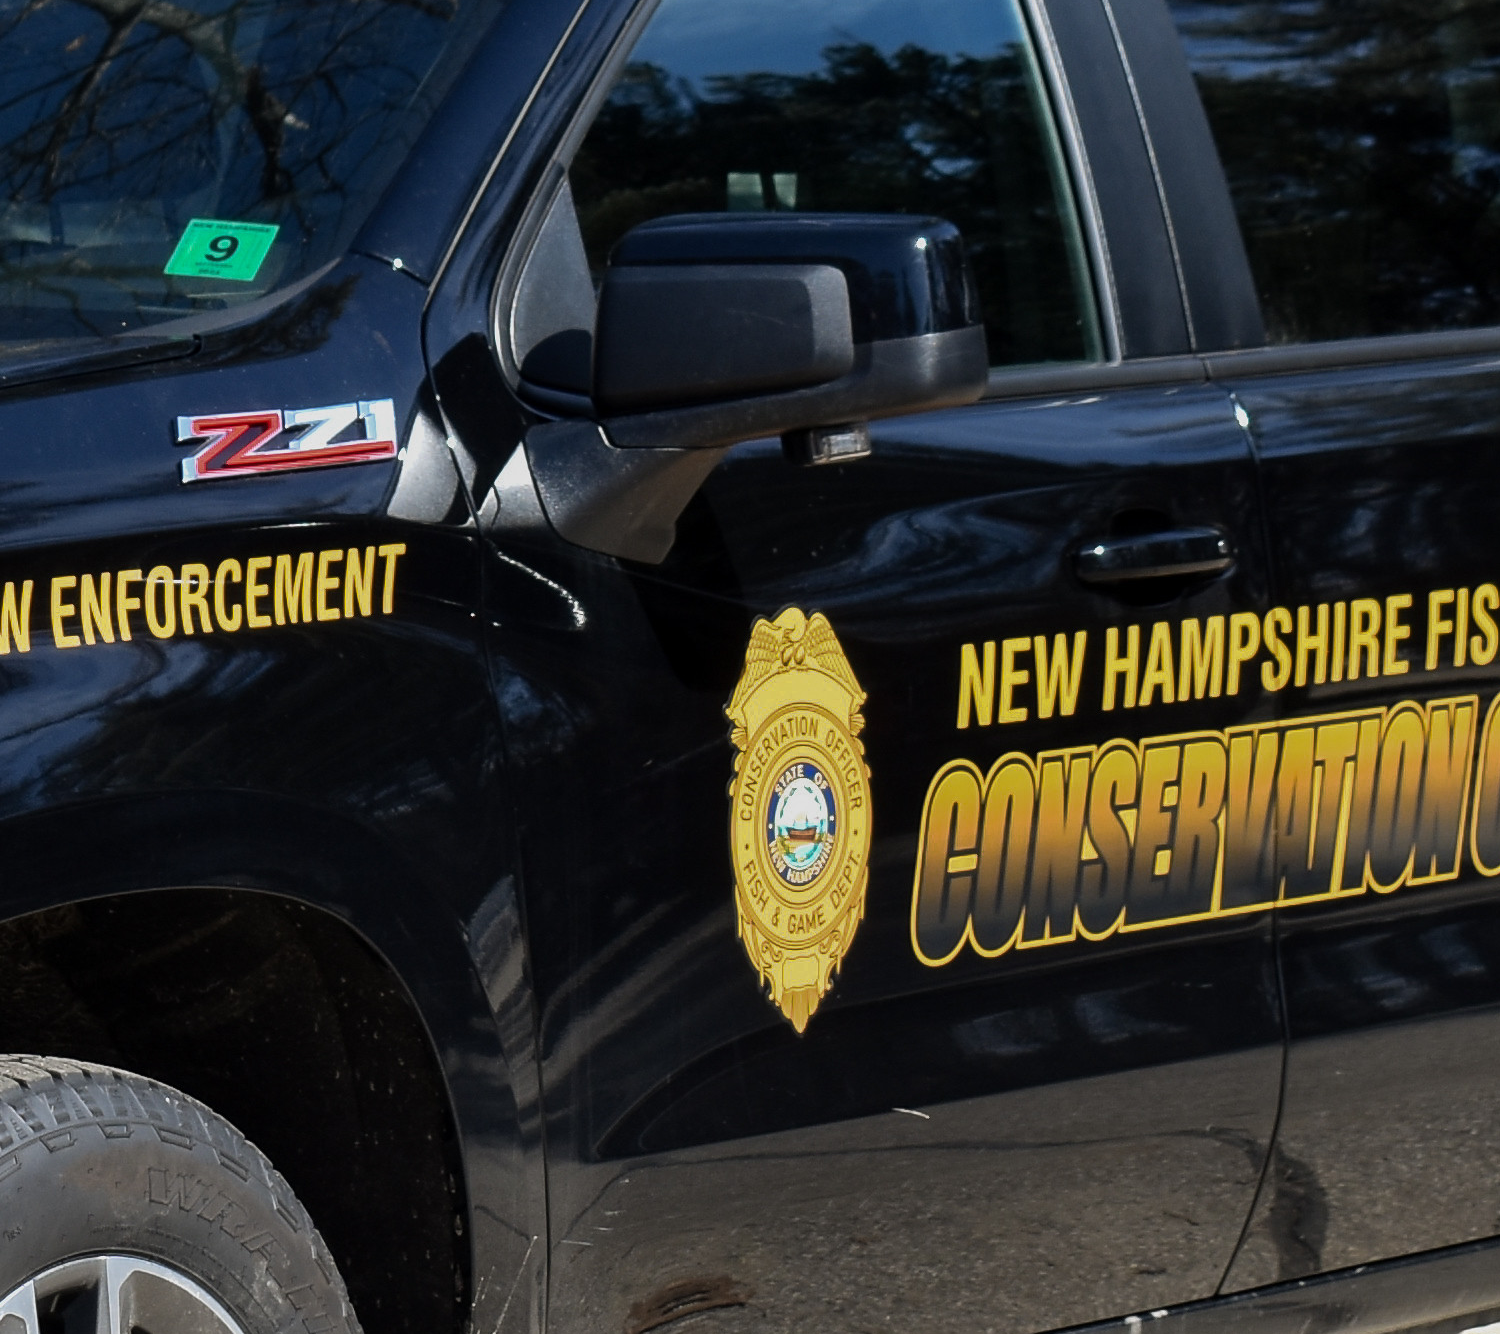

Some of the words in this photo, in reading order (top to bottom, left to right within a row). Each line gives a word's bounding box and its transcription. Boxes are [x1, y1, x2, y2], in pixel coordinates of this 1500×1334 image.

[204, 235, 239, 262] 9
[49, 543, 407, 649] ENFORCEMENT
[956, 630, 1088, 728] NEW
[1102, 593, 1412, 712] HAMPSHIRE
[739, 715, 820, 823] CONSERVATION
[825, 727, 863, 811] OFFICER
[774, 764, 805, 798] STATE
[813, 771, 829, 790] OF
[911, 693, 1479, 968] CONSERVATION
[742, 858, 770, 912] FISH
[771, 905, 782, 928] &
[786, 902, 826, 934] GAME
[829, 850, 863, 913] DEPT.
